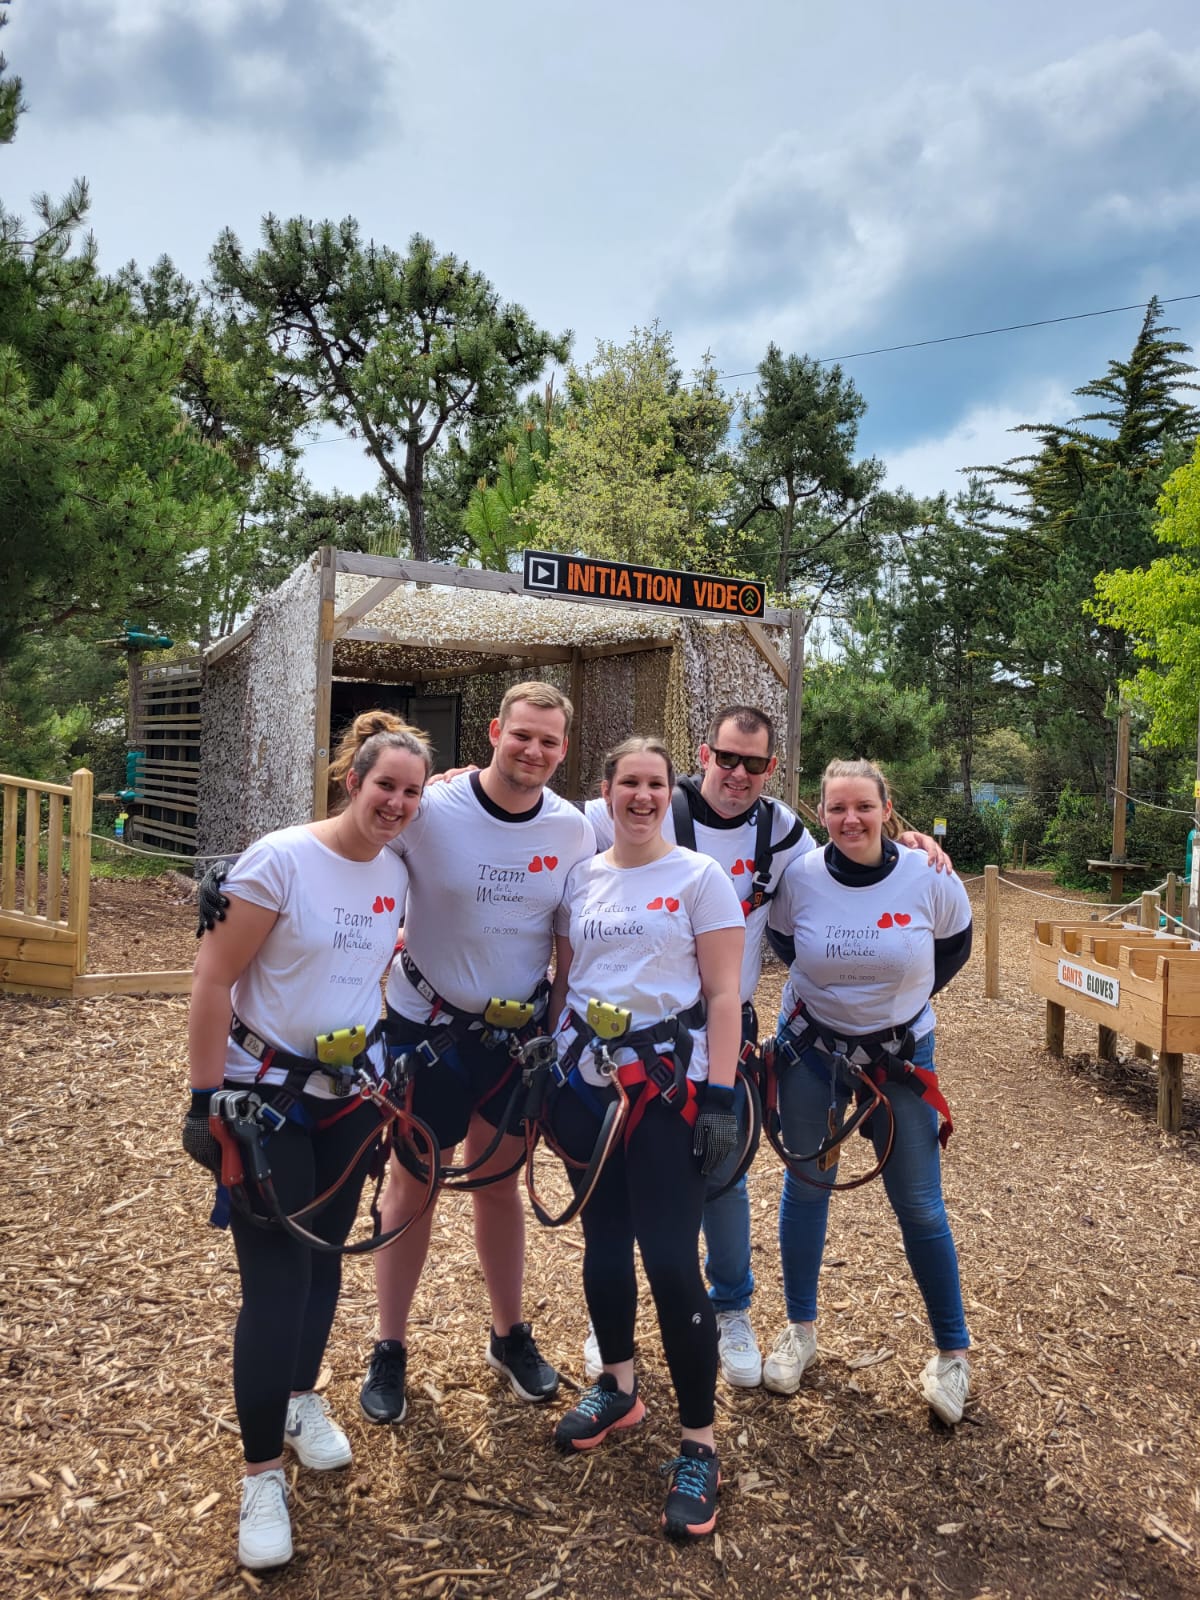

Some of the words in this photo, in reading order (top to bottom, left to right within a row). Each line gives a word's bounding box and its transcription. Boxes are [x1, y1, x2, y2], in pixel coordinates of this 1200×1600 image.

[567, 562, 681, 604] INITIATION
[478, 863, 525, 883] Team
[476, 885, 524, 905] Mariée
[596, 901, 637, 913] Future
[333, 907, 373, 928] Team
[583, 918, 645, 943] Mariée
[825, 925, 880, 940] Témoin
[332, 931, 373, 953] Mariée
[826, 942, 877, 960] Mariée
[1062, 965, 1083, 987] GANTS
[1086, 974, 1114, 1001] GLOVES
